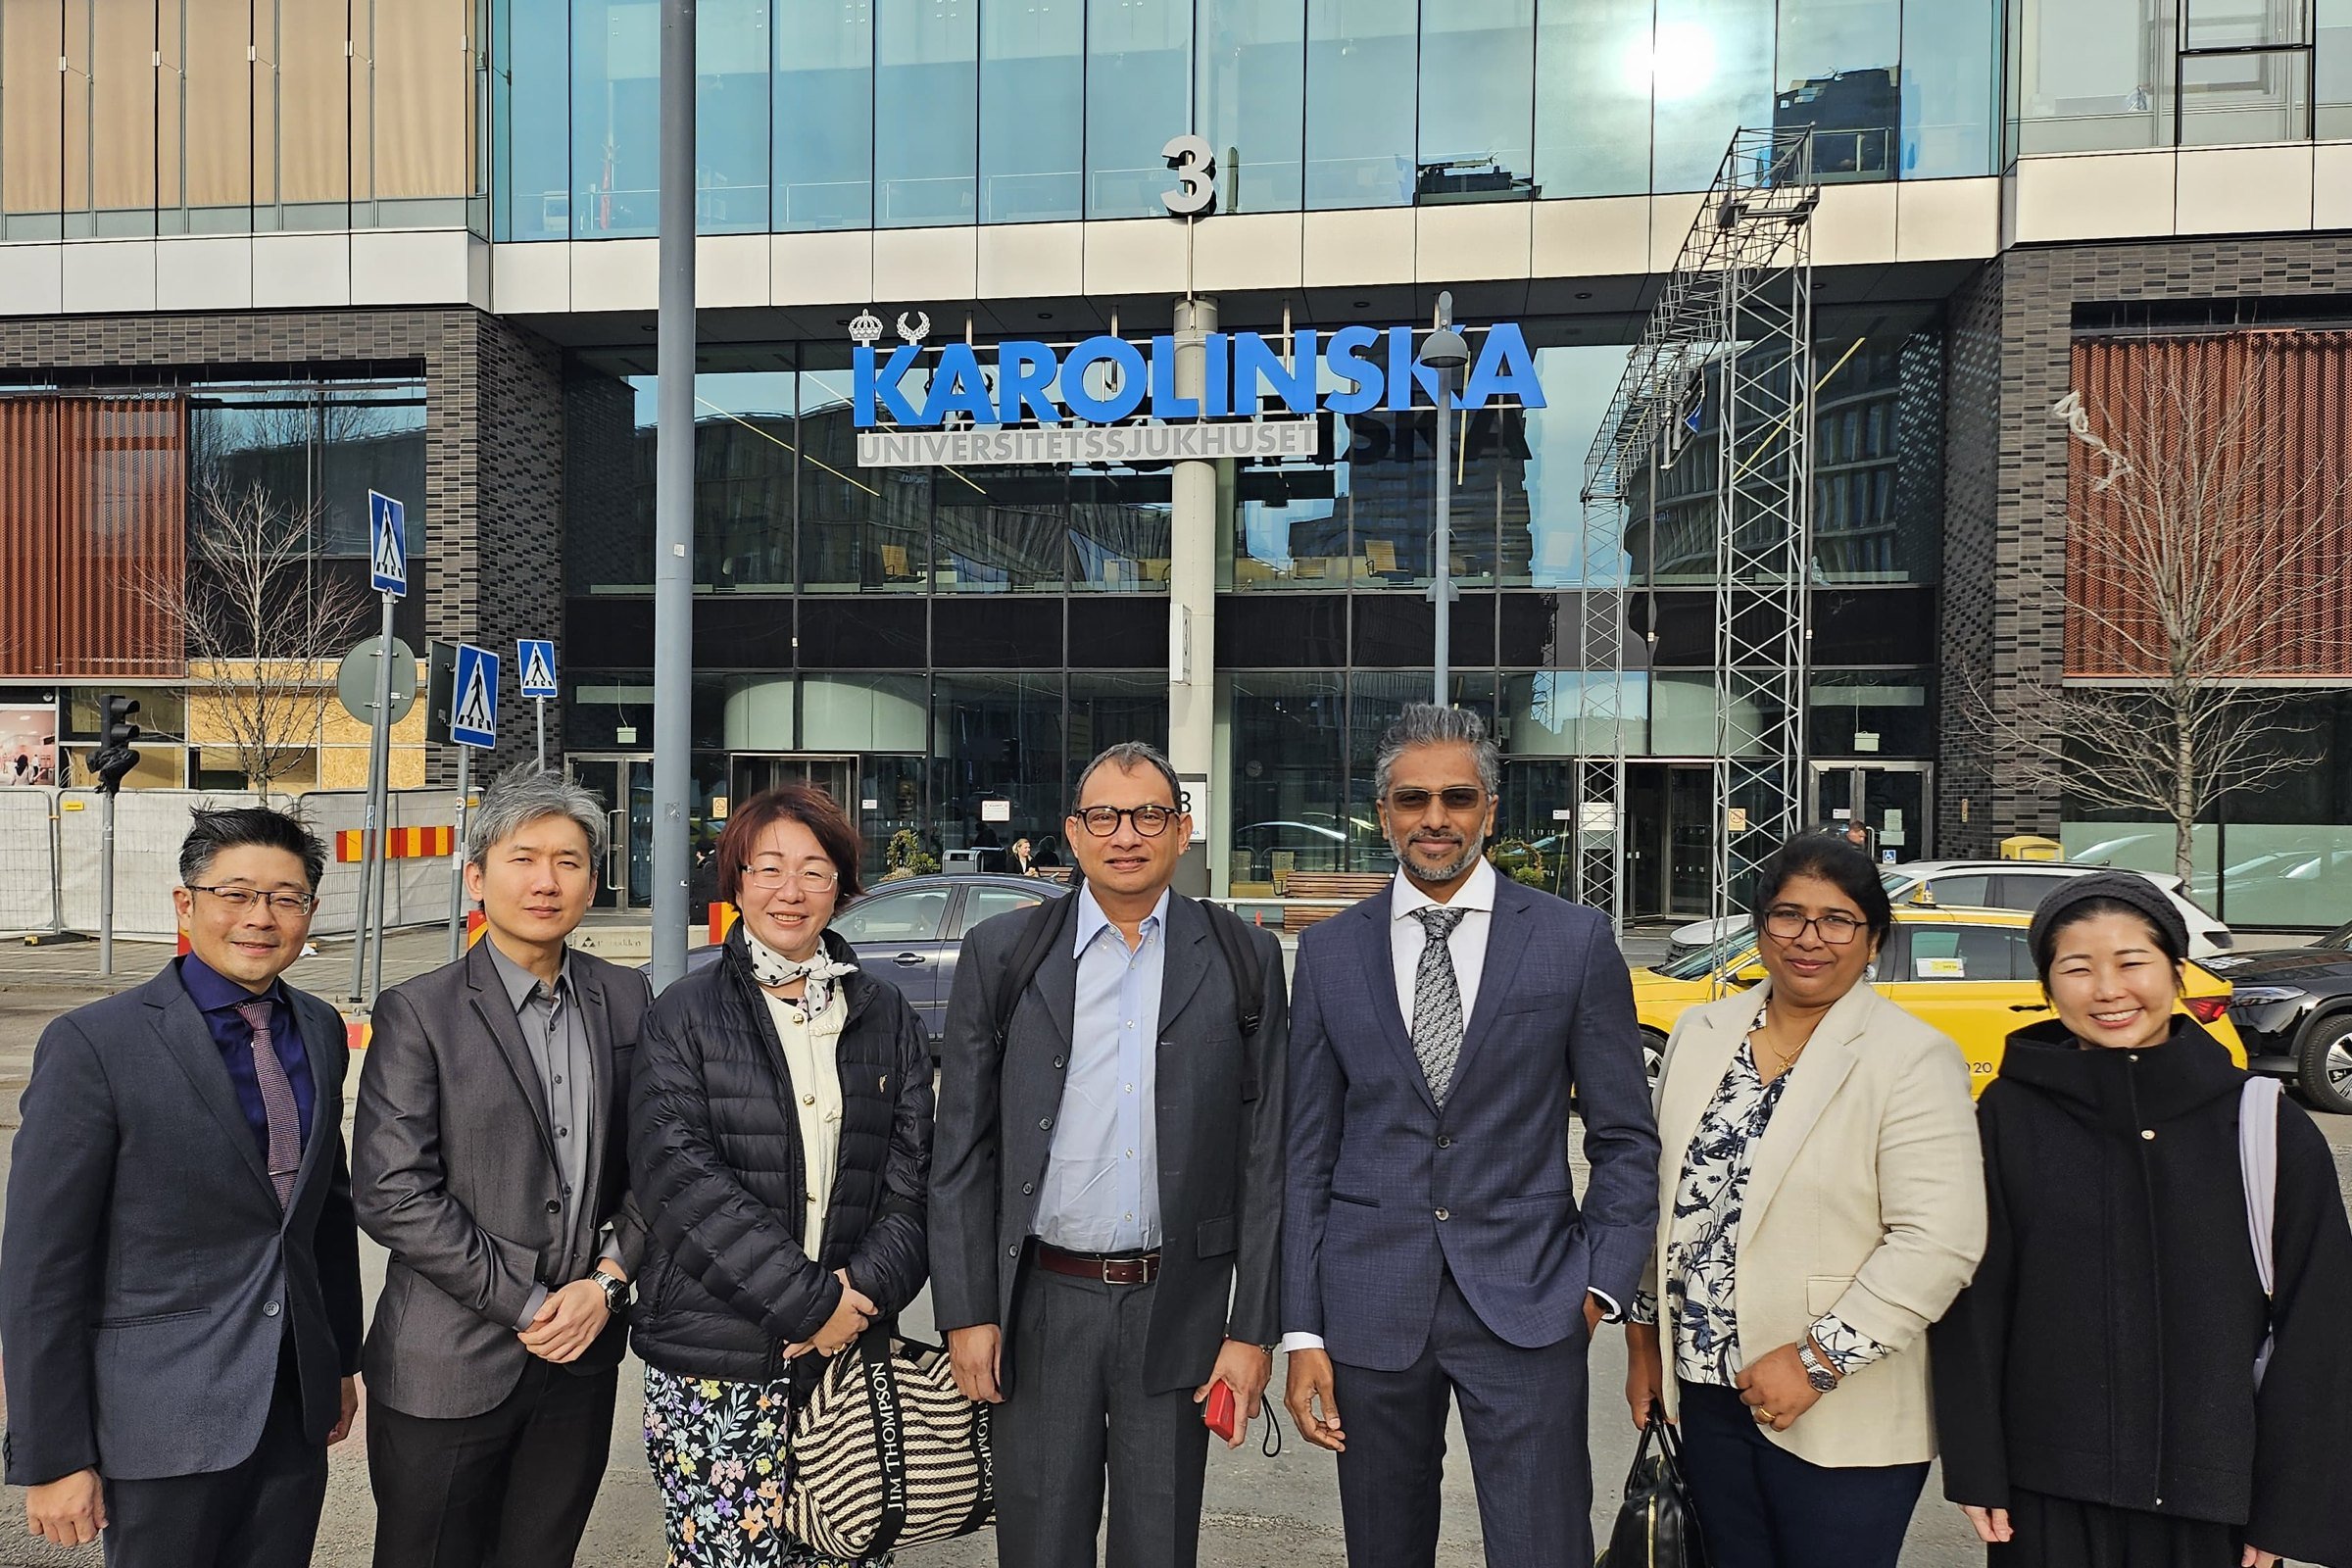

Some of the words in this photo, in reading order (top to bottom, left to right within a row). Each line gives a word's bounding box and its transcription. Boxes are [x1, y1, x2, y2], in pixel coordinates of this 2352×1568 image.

[1160, 134, 1215, 214] 3
[853, 322, 1547, 427] KAROLINSKA
[858, 422, 1317, 465] UNIVERSITETSSJUKHUSET
[1973, 1061, 1992, 1074] 20
[870, 1362, 901, 1473] THOMPSON
[887, 1477, 905, 1512] JIM
